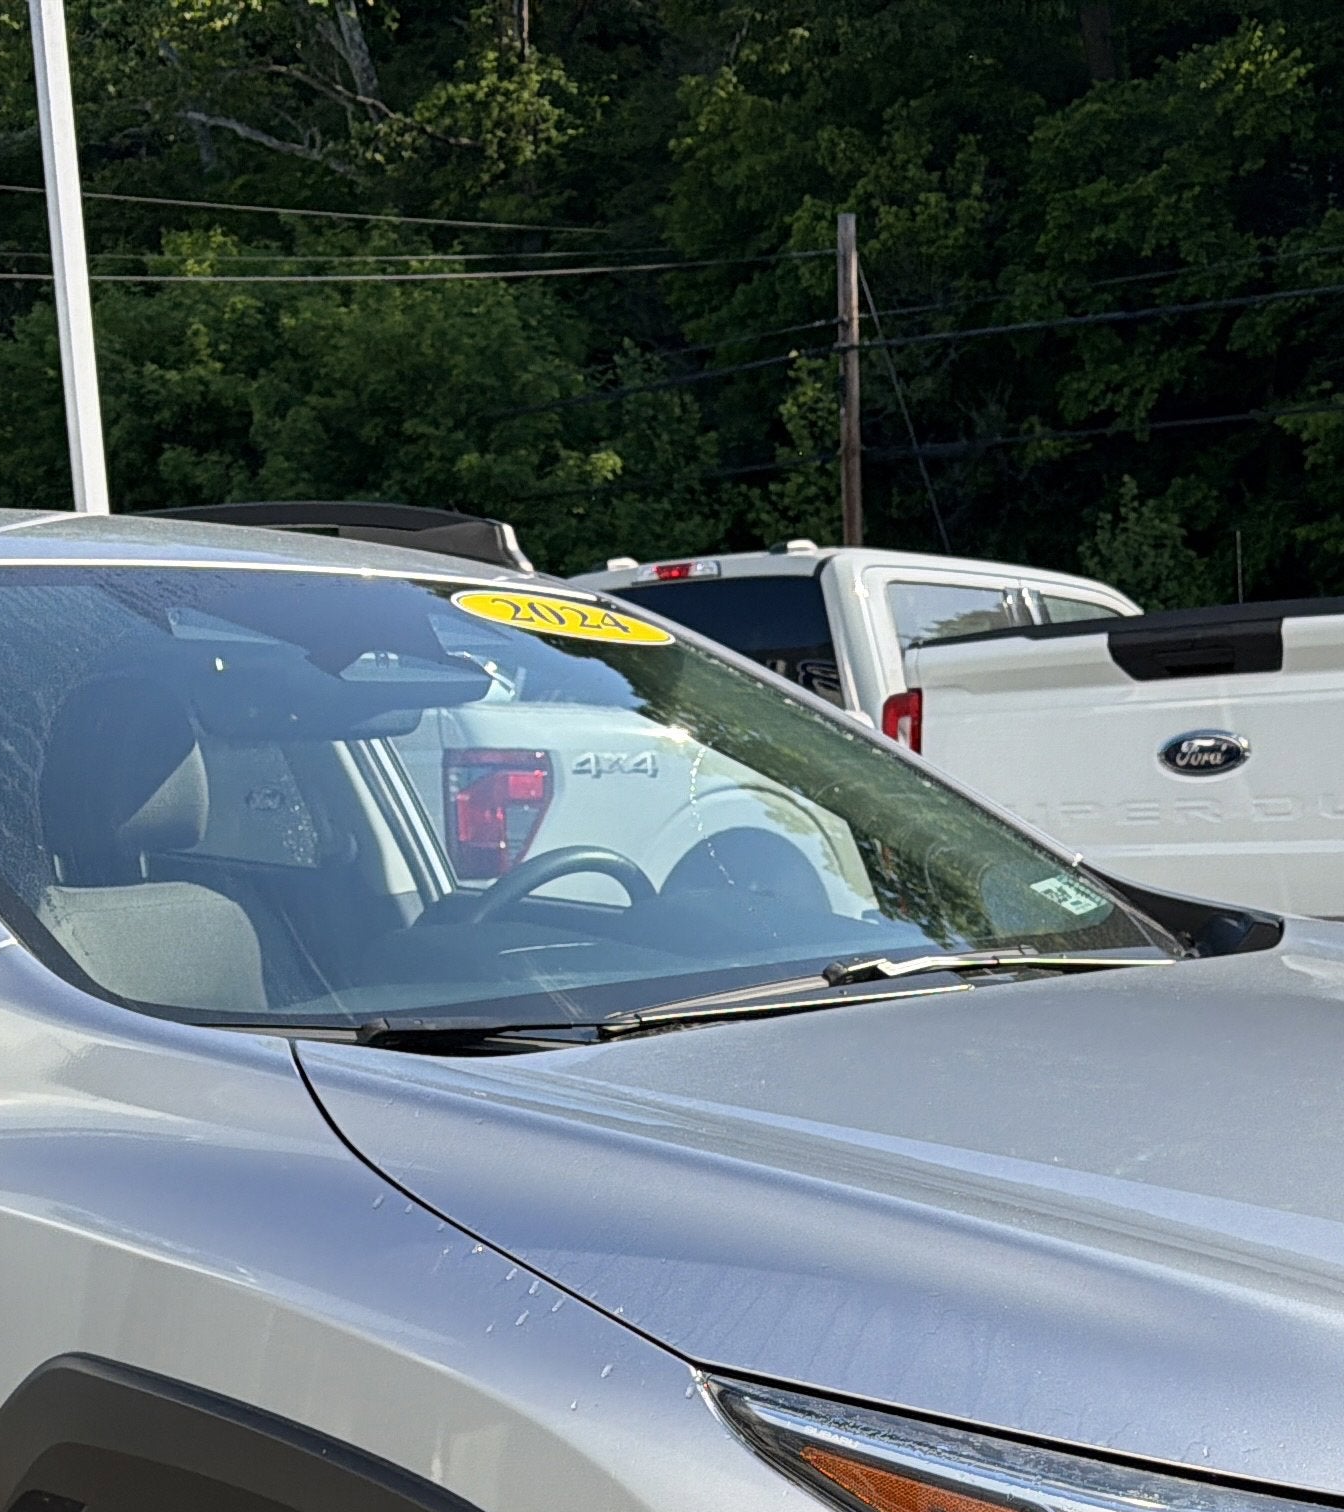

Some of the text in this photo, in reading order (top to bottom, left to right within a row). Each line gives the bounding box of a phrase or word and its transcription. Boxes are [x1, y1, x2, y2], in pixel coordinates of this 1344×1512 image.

[490, 598, 632, 633] 2024
[1175, 738, 1229, 767] Ford
[1006, 797, 1223, 827] PER
